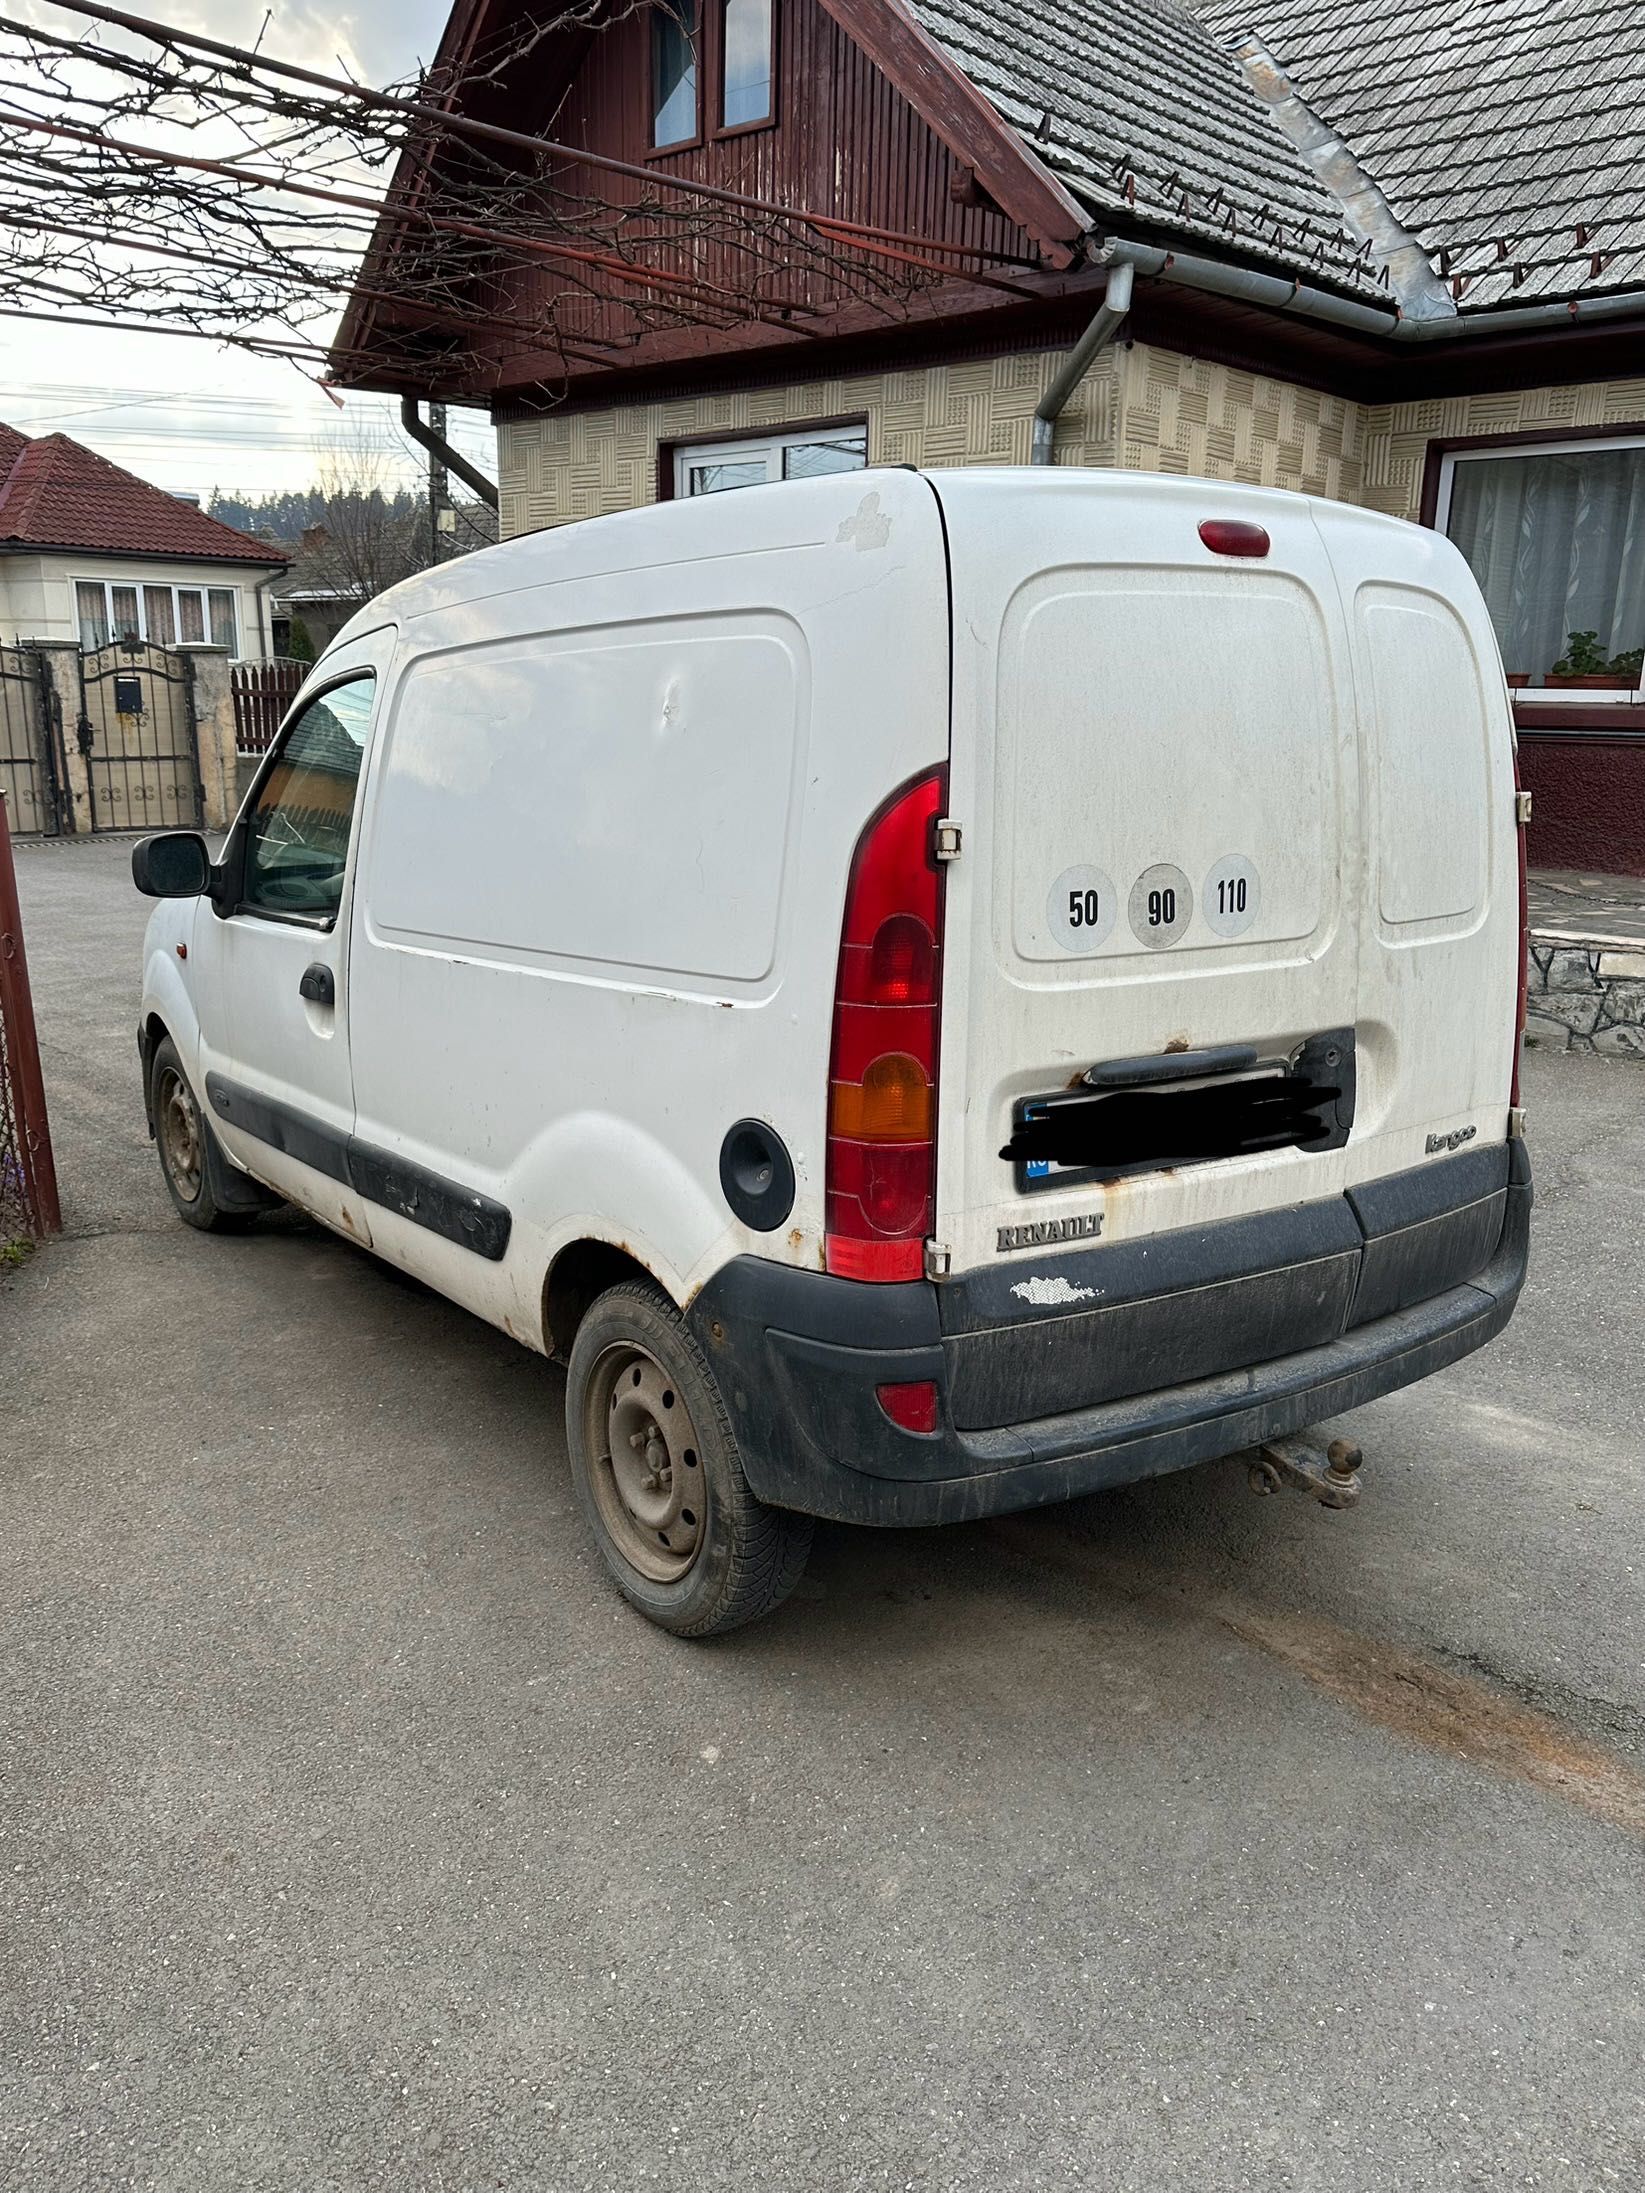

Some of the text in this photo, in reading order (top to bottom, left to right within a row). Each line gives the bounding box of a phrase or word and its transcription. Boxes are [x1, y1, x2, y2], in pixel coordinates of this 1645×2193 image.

[1069, 889, 1099, 928] 50
[1148, 888, 1176, 926] 90
[1217, 877, 1247, 914] 110
[996, 1212, 1104, 1252] RENAULT
